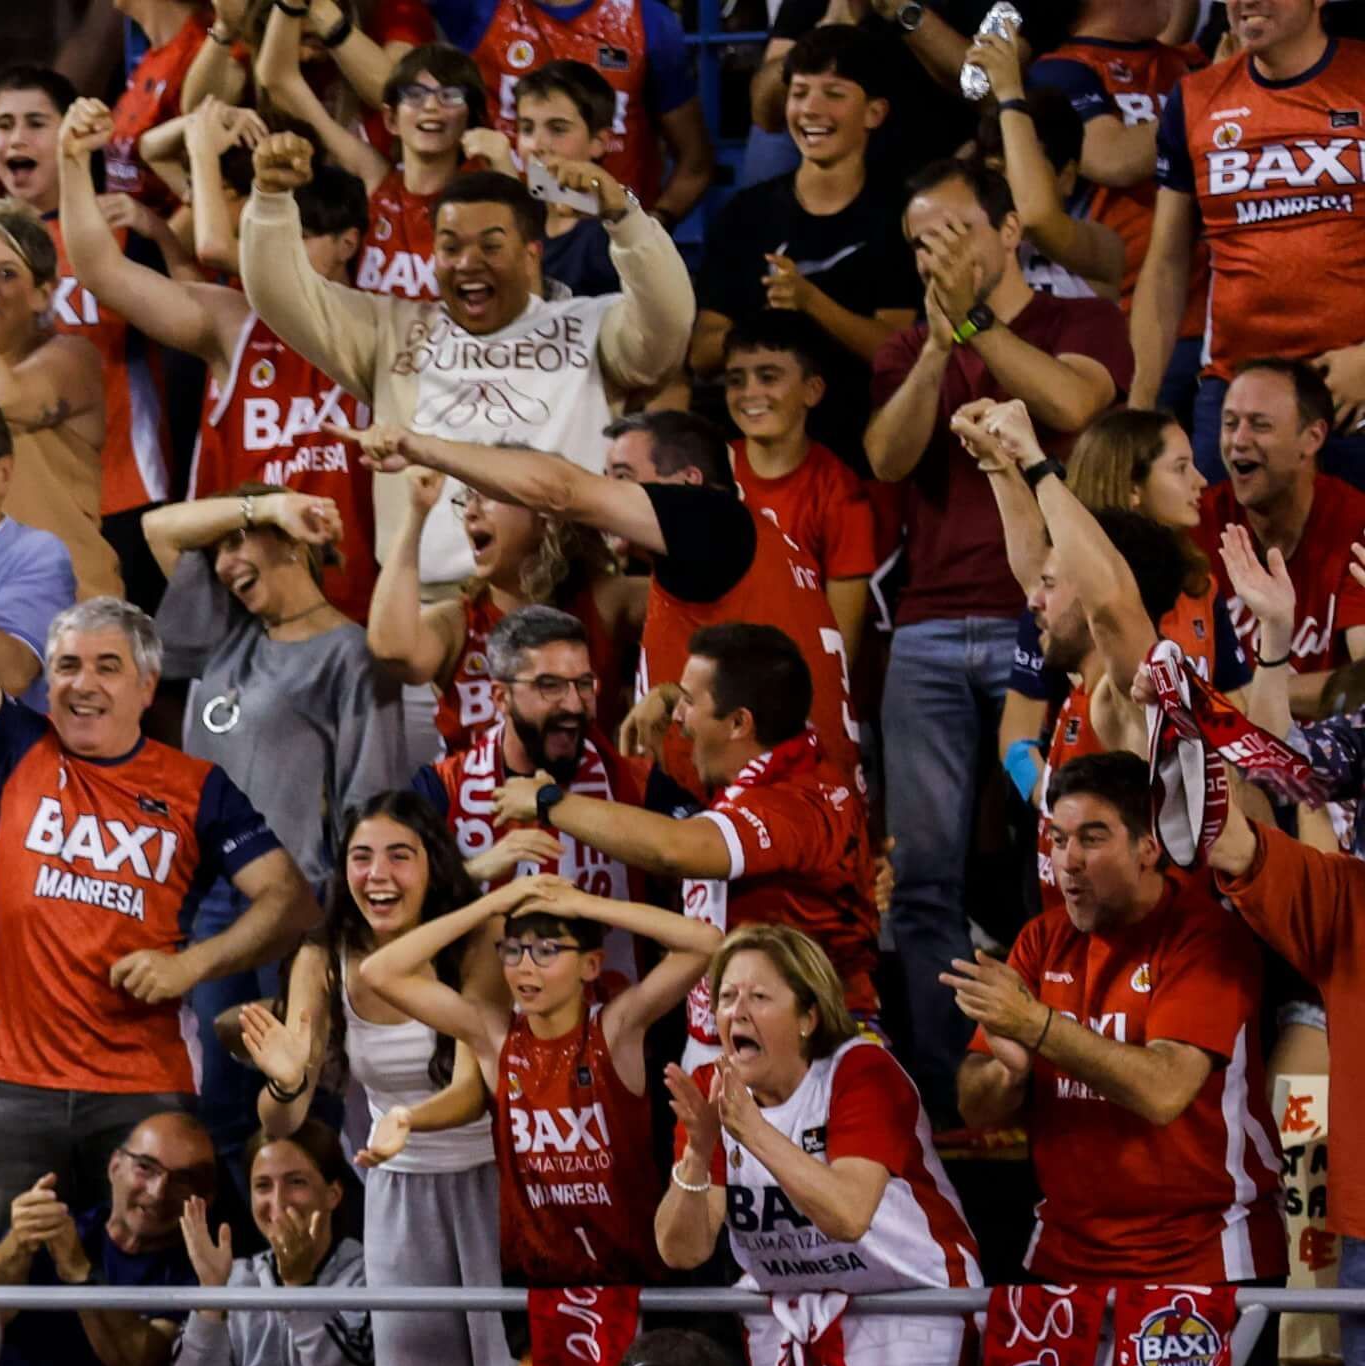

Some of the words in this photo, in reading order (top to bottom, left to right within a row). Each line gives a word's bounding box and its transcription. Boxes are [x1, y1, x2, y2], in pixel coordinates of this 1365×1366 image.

[24, 796, 178, 885] BAXI
[34, 863, 145, 921] MANRESA
[509, 1101, 611, 1154] BAXI
[1142, 1333, 1218, 1361] BAXI
